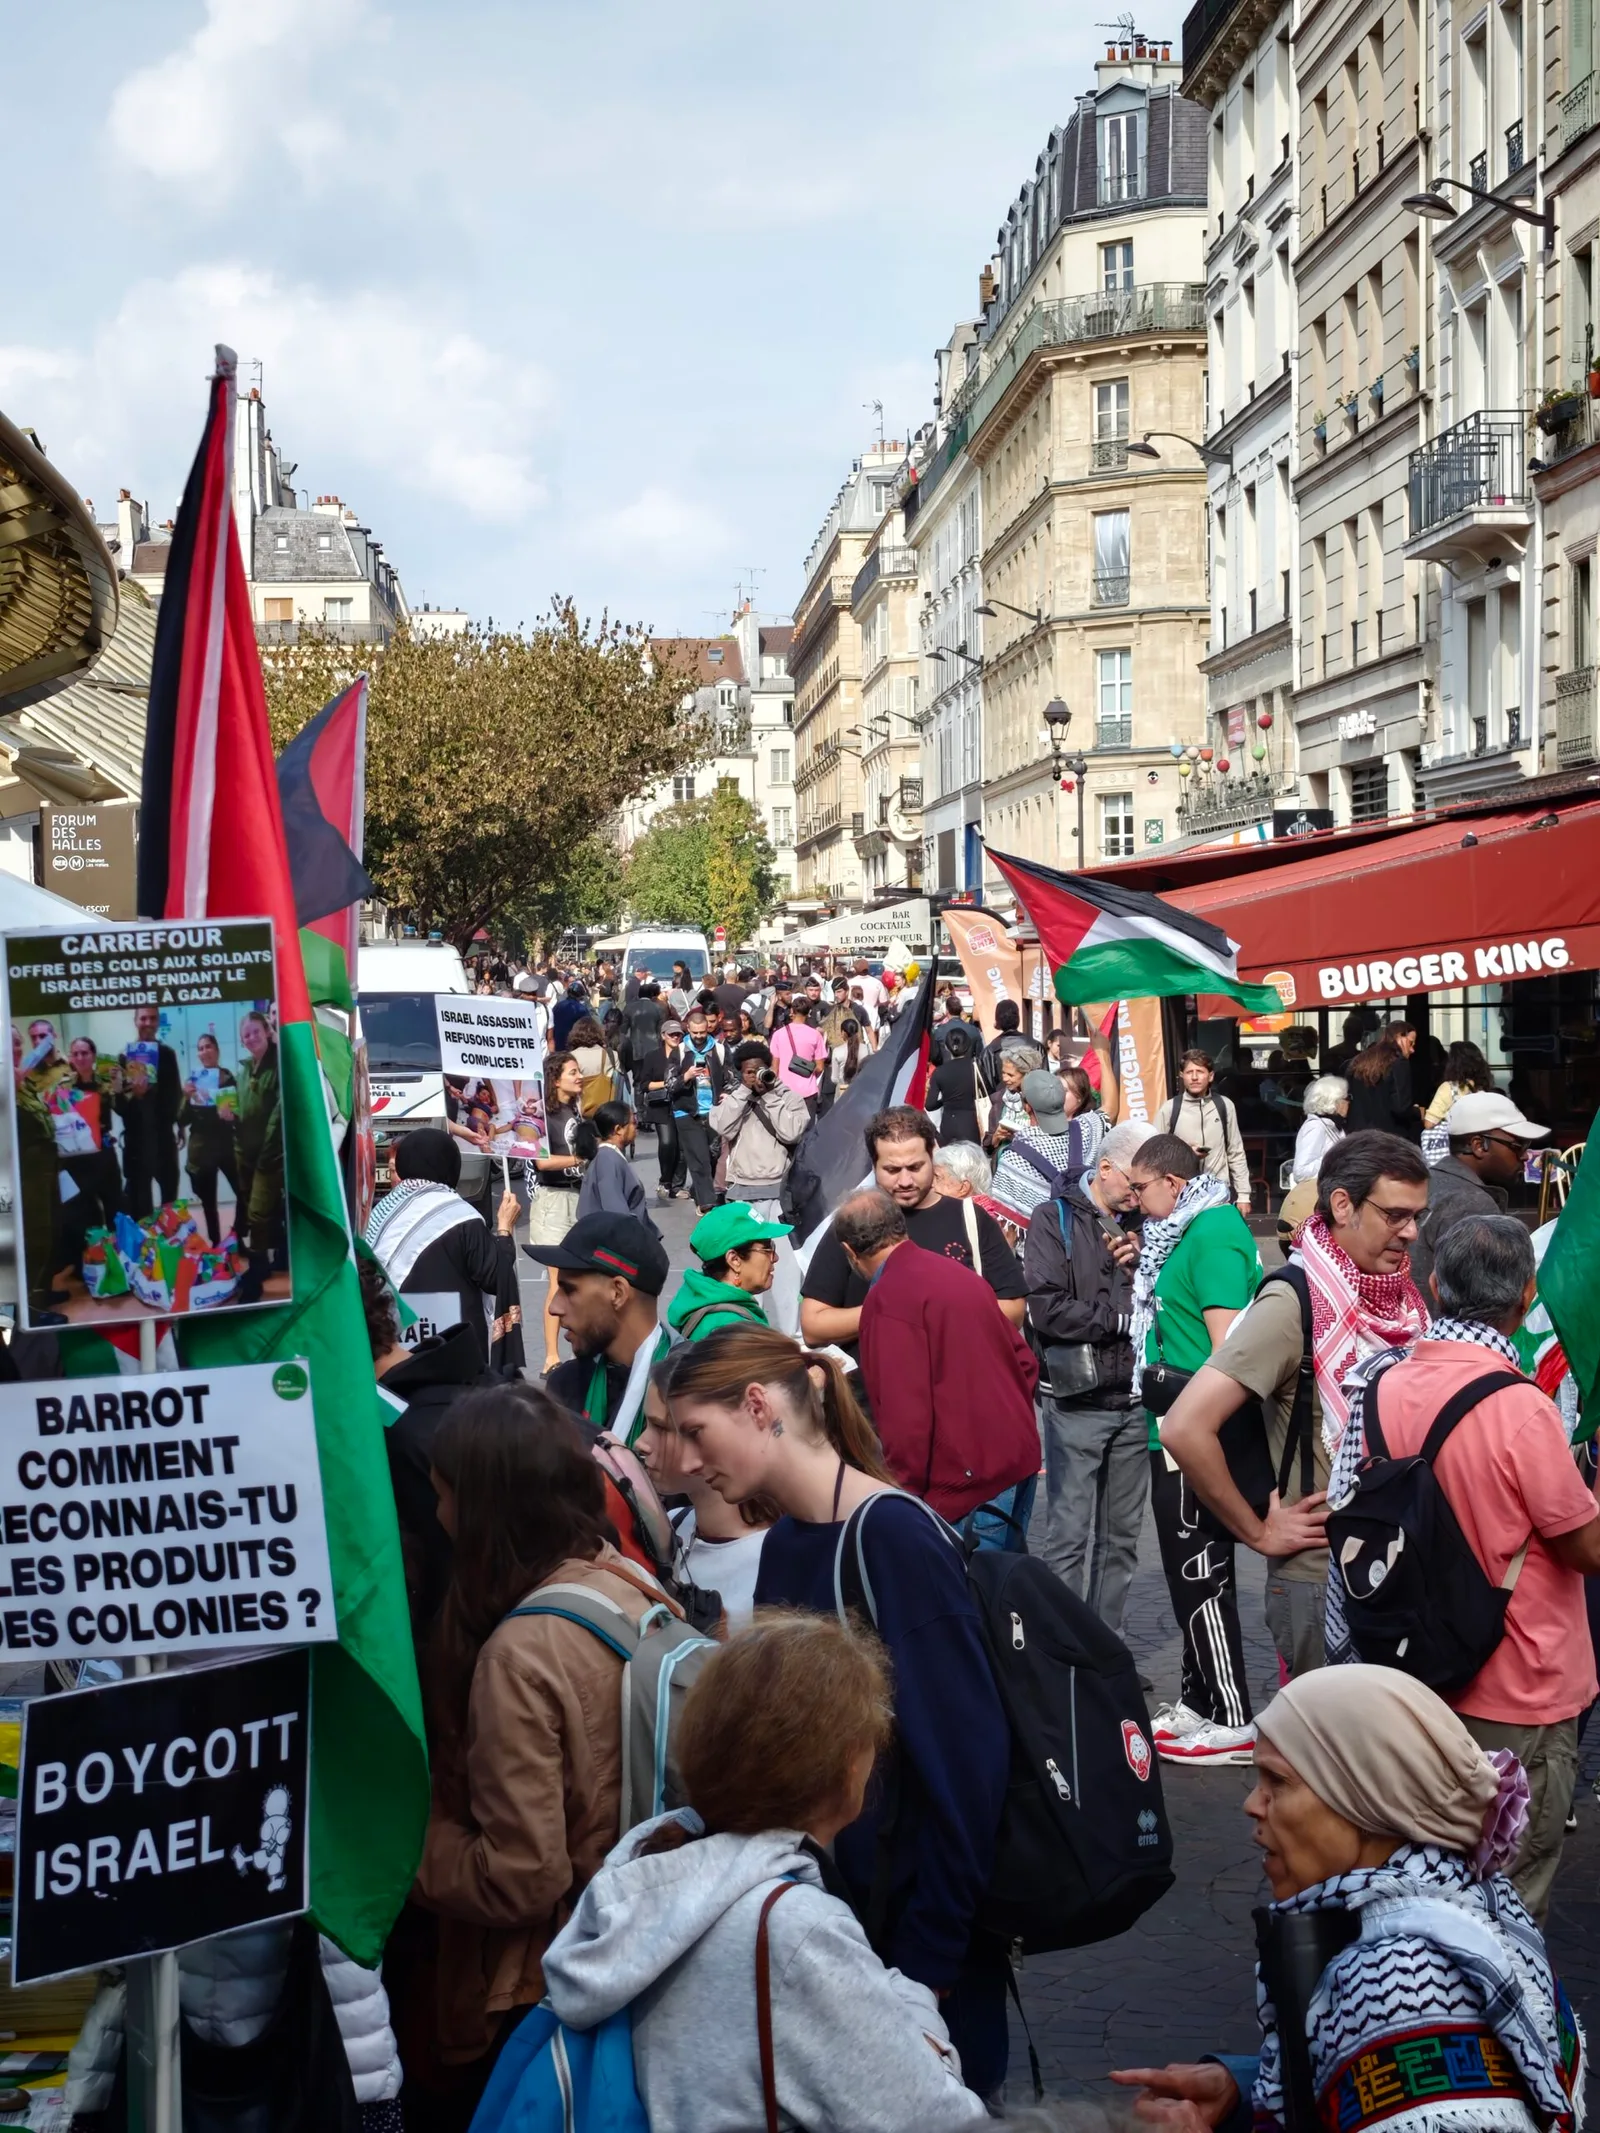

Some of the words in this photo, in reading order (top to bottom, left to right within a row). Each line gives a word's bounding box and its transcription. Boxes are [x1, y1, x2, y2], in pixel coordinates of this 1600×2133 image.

[51, 814, 97, 826] FORUM
[51, 827, 77, 839] DES
[52, 839, 102, 851] HALLES
[82, 905, 111, 913] ESCOT
[892, 911, 910, 919] BAR
[860, 921, 911, 931] COCKTAILS
[60, 928, 223, 956] CARREFOUR
[840, 936, 852, 945] LE
[854, 935, 875, 944] BON
[9, 963, 66, 979] OFFRE
[70, 960, 104, 975] DES
[108, 957, 159, 972] COLIS
[163, 955, 197, 968] AUX
[201, 950, 272, 966] SOLDATS
[1319, 953, 1468, 999] BURGER
[1474, 937, 1570, 976] KING
[40, 974, 142, 994] ISRAÉLIENS
[146, 971, 223, 987] PENDANT
[227, 968, 246, 982] LE
[69, 988, 158, 1009] GÉNOCIDE
[163, 986, 174, 1002] À
[177, 986, 222, 1001] GAZA
[441, 1010, 475, 1025] ISRAEL
[476, 1014, 527, 1029] ASSASSIN
[528, 1018, 532, 1028] !
[444, 1030, 496, 1048] REFUSONS
[497, 1037, 535, 1049] D'ETRE
[461, 1052, 519, 1068] COMPLICES
[520, 1057, 525, 1069] !
[398, 1317, 437, 1343] AËL
[36, 1384, 210, 1436] BARROT
[18, 1435, 240, 1490] COMMENT
[0, 1483, 298, 1544] ECONNAIS-TU
[73, 1537, 296, 1592] PRODUITS
[0, 1608, 59, 1649] ES
[67, 1590, 289, 1645] COLONIES
[297, 1587, 321, 1628] ?
[34, 1712, 298, 1815] BOYCOTT
[34, 1815, 225, 1900] ISRAEL
